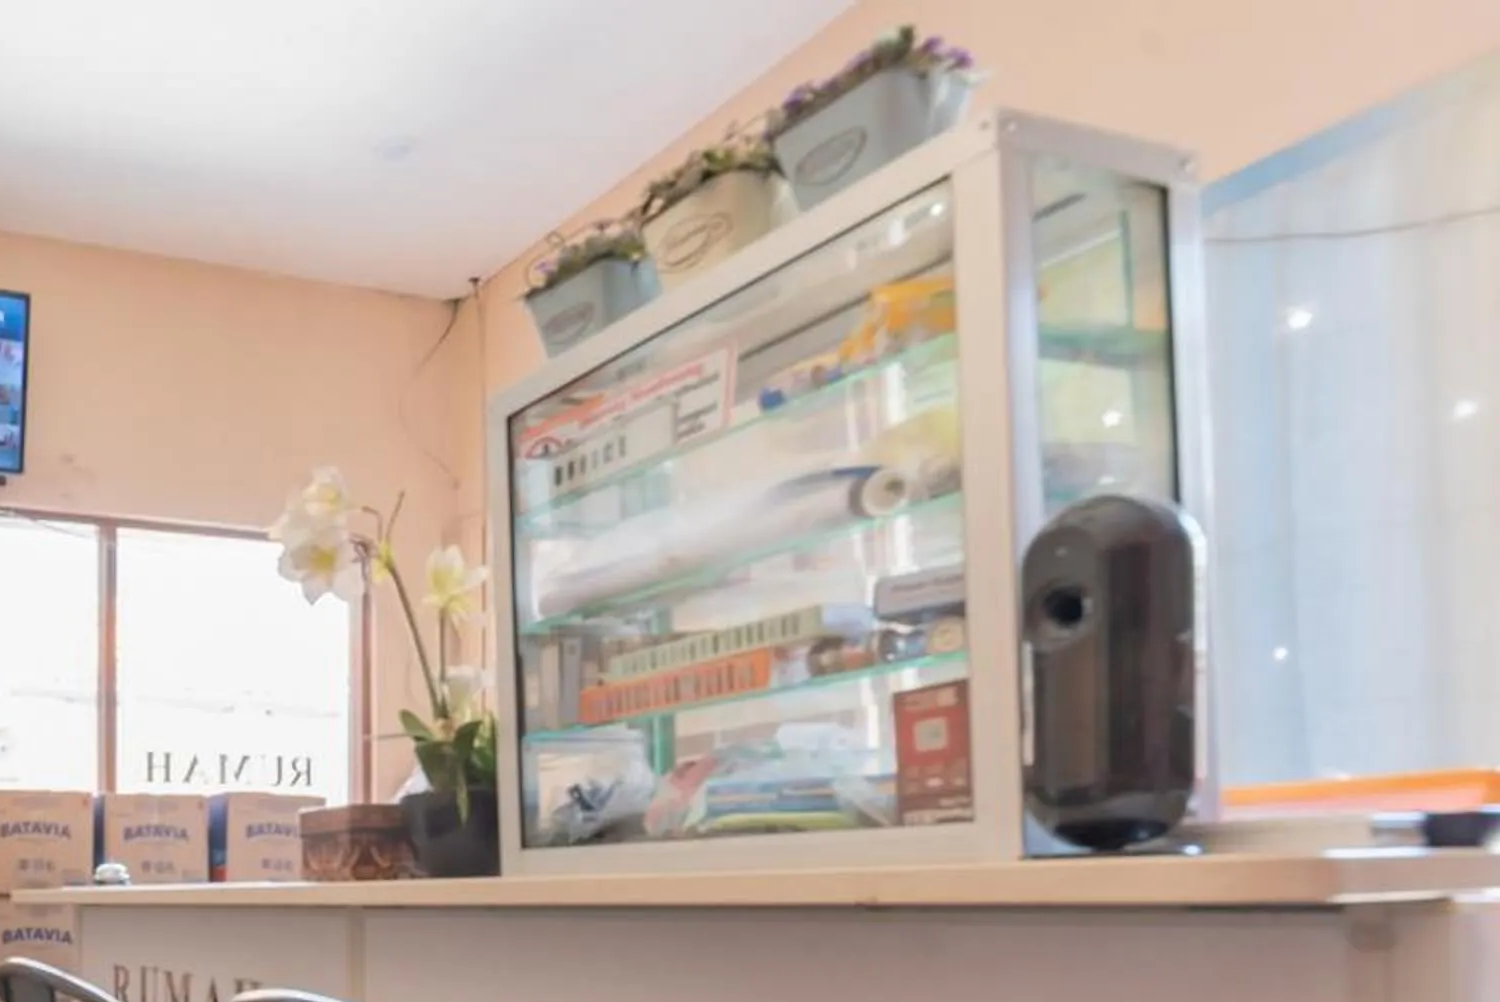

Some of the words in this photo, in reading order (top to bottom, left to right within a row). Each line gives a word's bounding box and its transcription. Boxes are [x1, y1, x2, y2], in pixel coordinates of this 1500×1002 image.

[0, 820, 72, 839] BATAVIA
[122, 823, 190, 842] BATAVIA
[246, 822, 300, 839] BATAVI
[1, 926, 73, 945] BATAVIA
